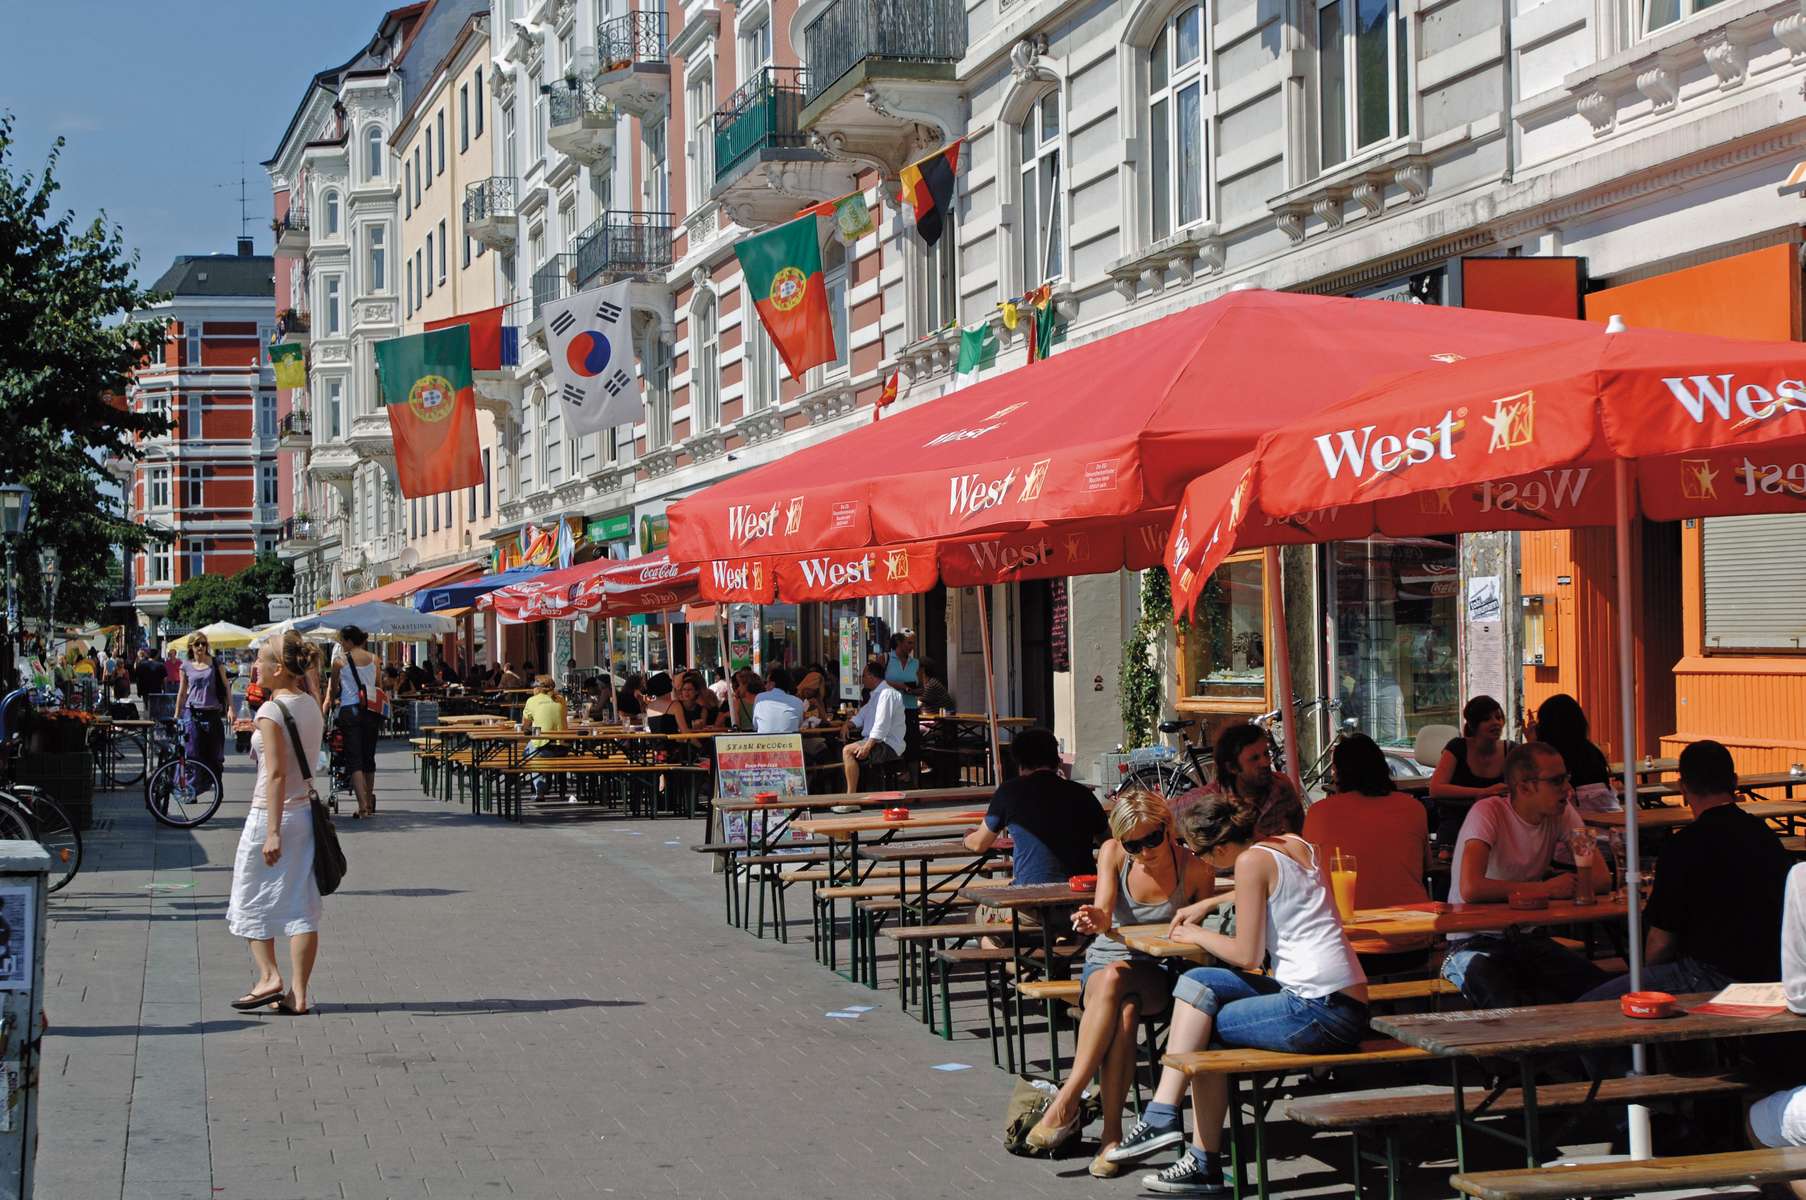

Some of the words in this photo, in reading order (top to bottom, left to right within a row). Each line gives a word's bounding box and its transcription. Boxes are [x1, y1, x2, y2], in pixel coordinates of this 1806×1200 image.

[1661, 374, 1806, 423] Wes
[1313, 410, 1457, 479] West
[950, 468, 1015, 515] West
[728, 501, 778, 541] West
[798, 553, 872, 588] West
[968, 537, 1048, 570] West
[639, 563, 679, 583] Coca-Cola
[712, 560, 748, 590] West
